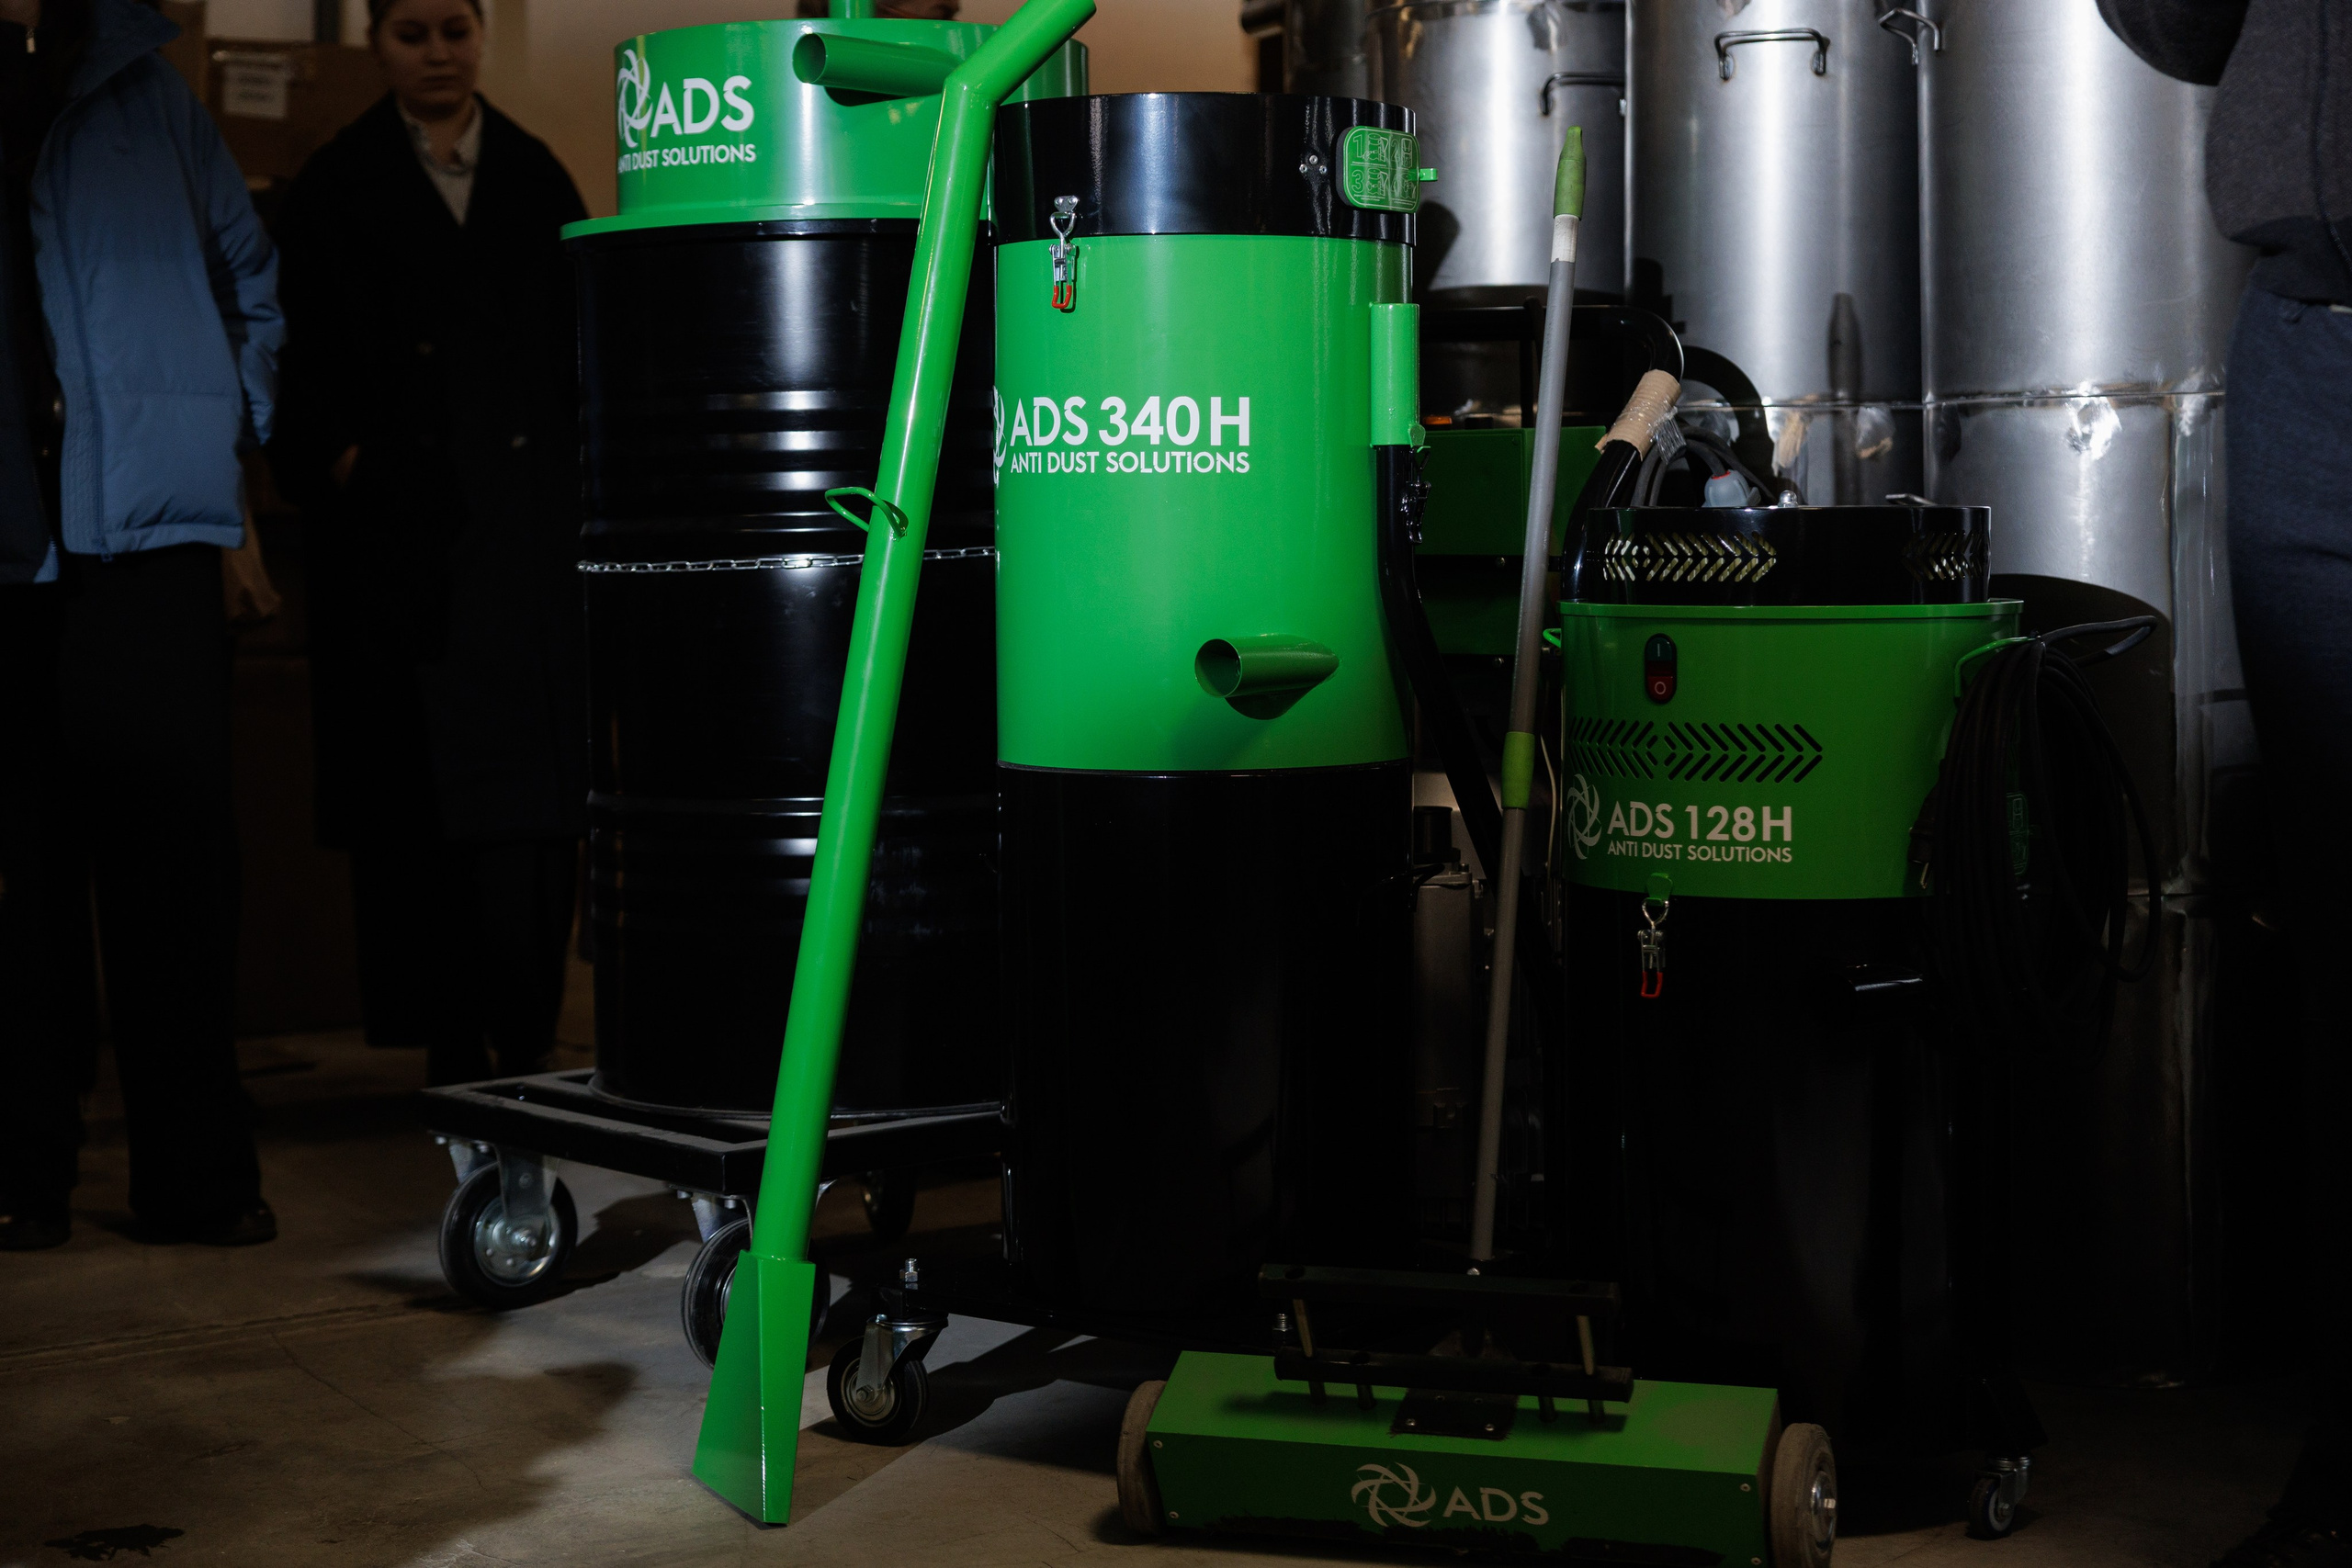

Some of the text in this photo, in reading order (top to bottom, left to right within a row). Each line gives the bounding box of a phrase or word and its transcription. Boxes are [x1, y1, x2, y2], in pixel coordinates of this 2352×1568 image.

[650, 74, 755, 138] ADS
[631, 149, 661, 171] DUST
[662, 143, 756, 166] SOLUTIONS
[1010, 395, 1089, 446] ADS
[1010, 451, 1250, 474] ANTI DUST SOLUTIONS
[1607, 800, 1675, 839] ADS
[1608, 840, 1792, 863] ANTI DUST SOLUTIONS
[1442, 1484, 1550, 1526] ADS
